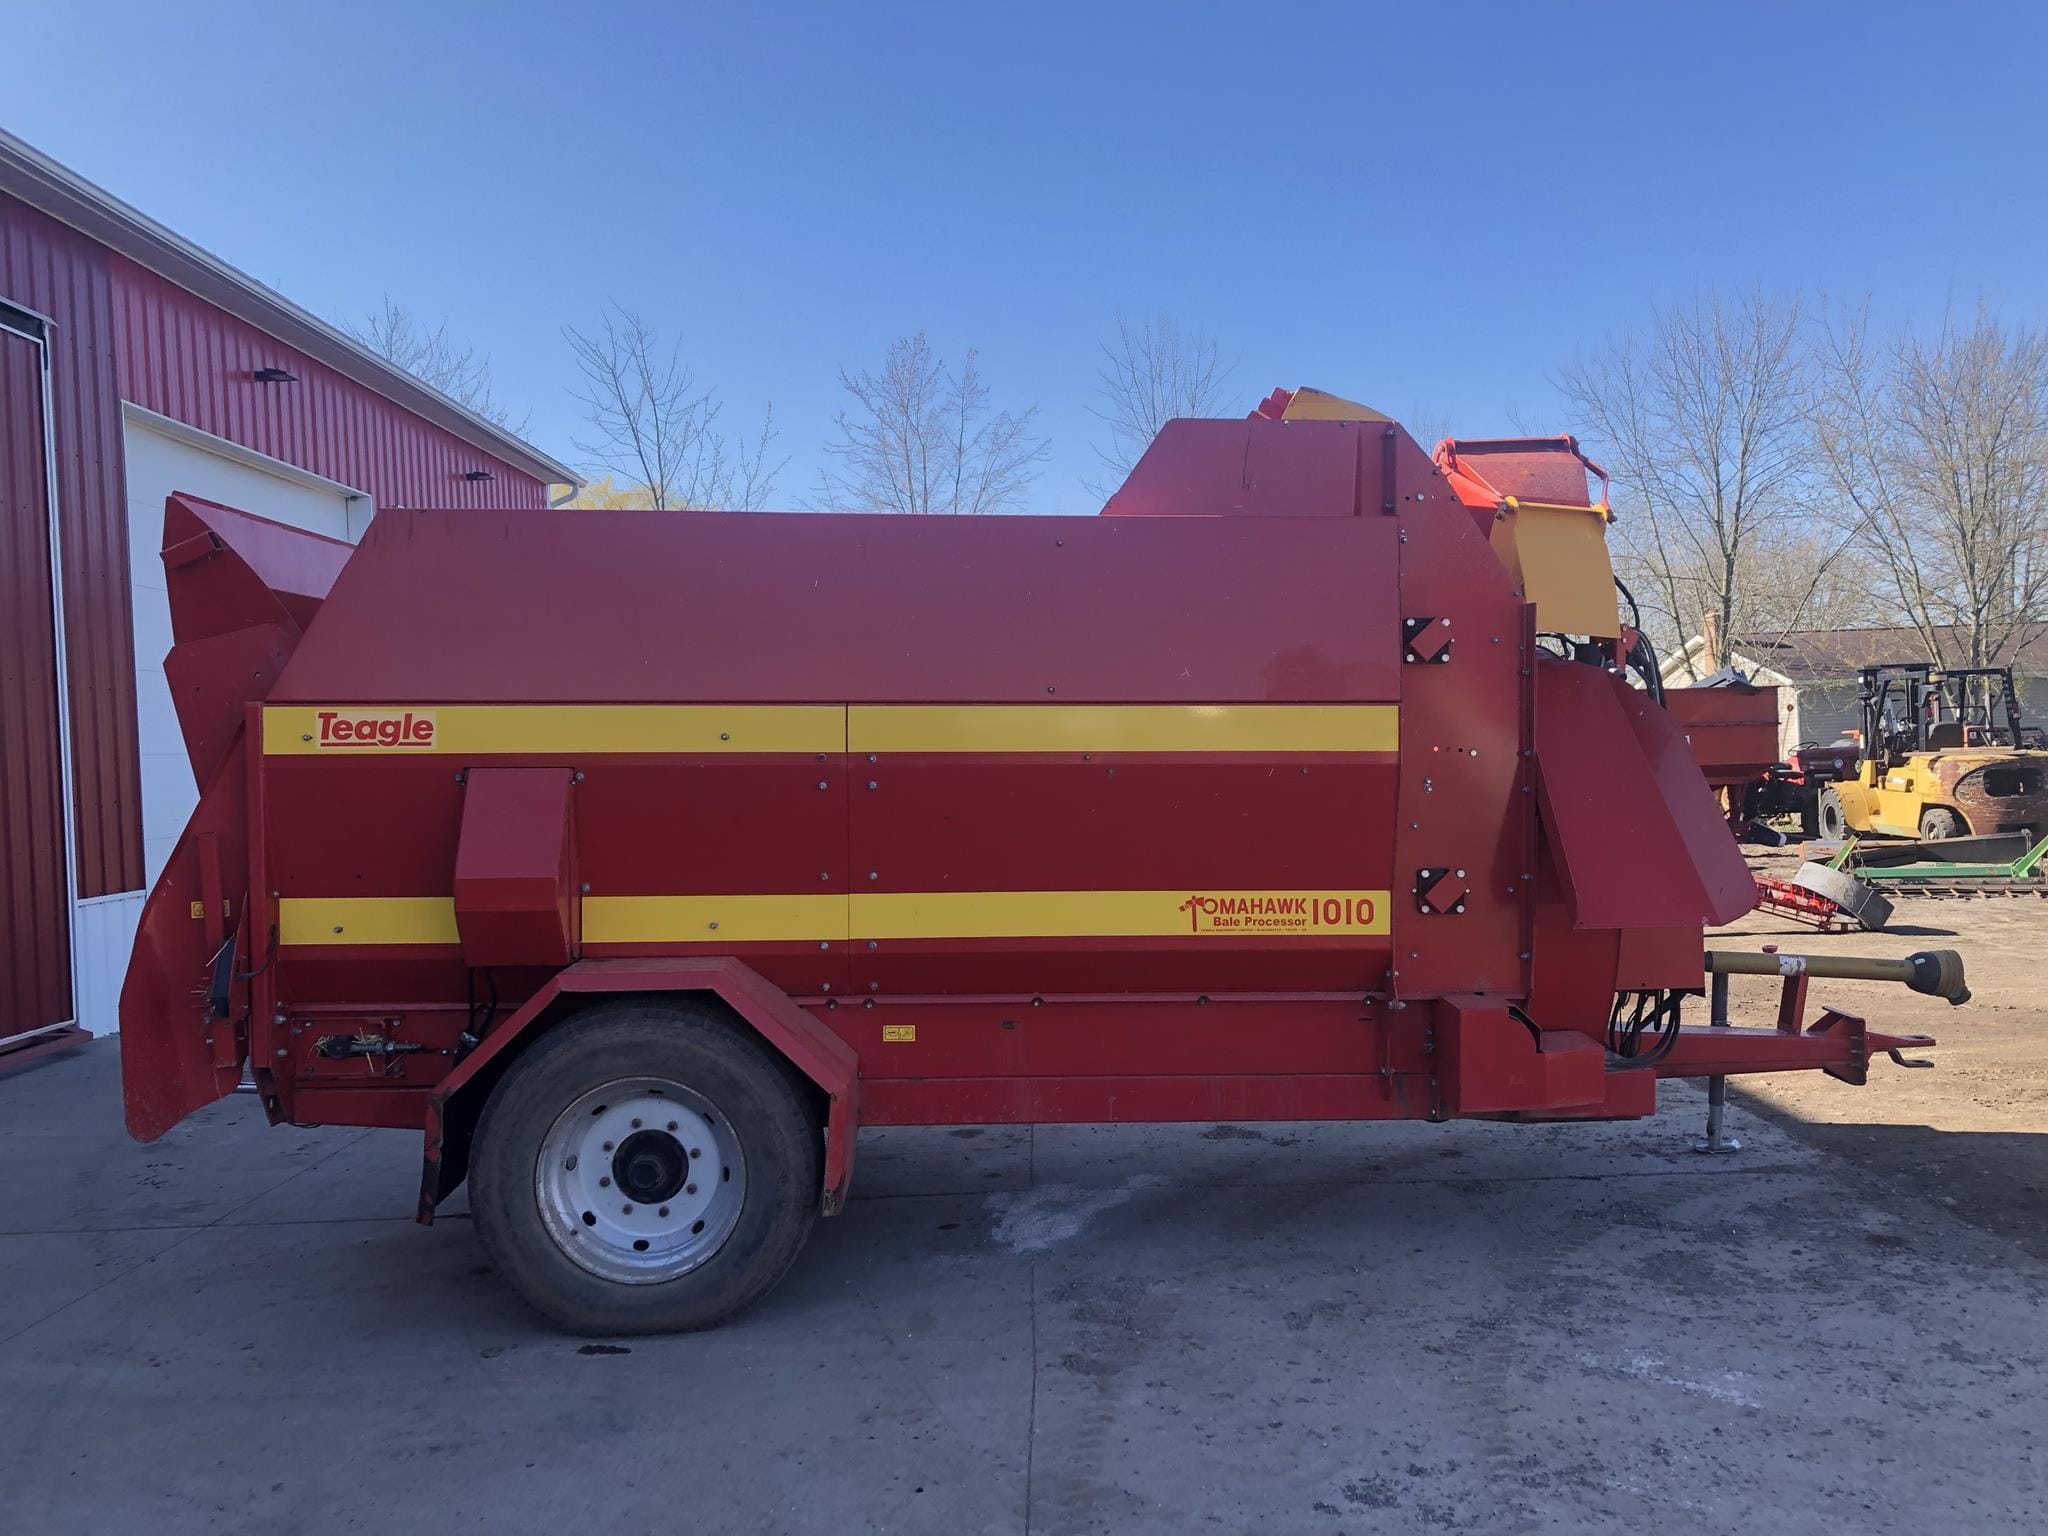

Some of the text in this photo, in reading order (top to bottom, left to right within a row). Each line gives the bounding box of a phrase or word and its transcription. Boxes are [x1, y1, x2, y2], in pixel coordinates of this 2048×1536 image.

[318, 712, 434, 747] Teagle
[1213, 916, 1308, 927] Bale Processor
[1312, 898, 1375, 925] 1010
